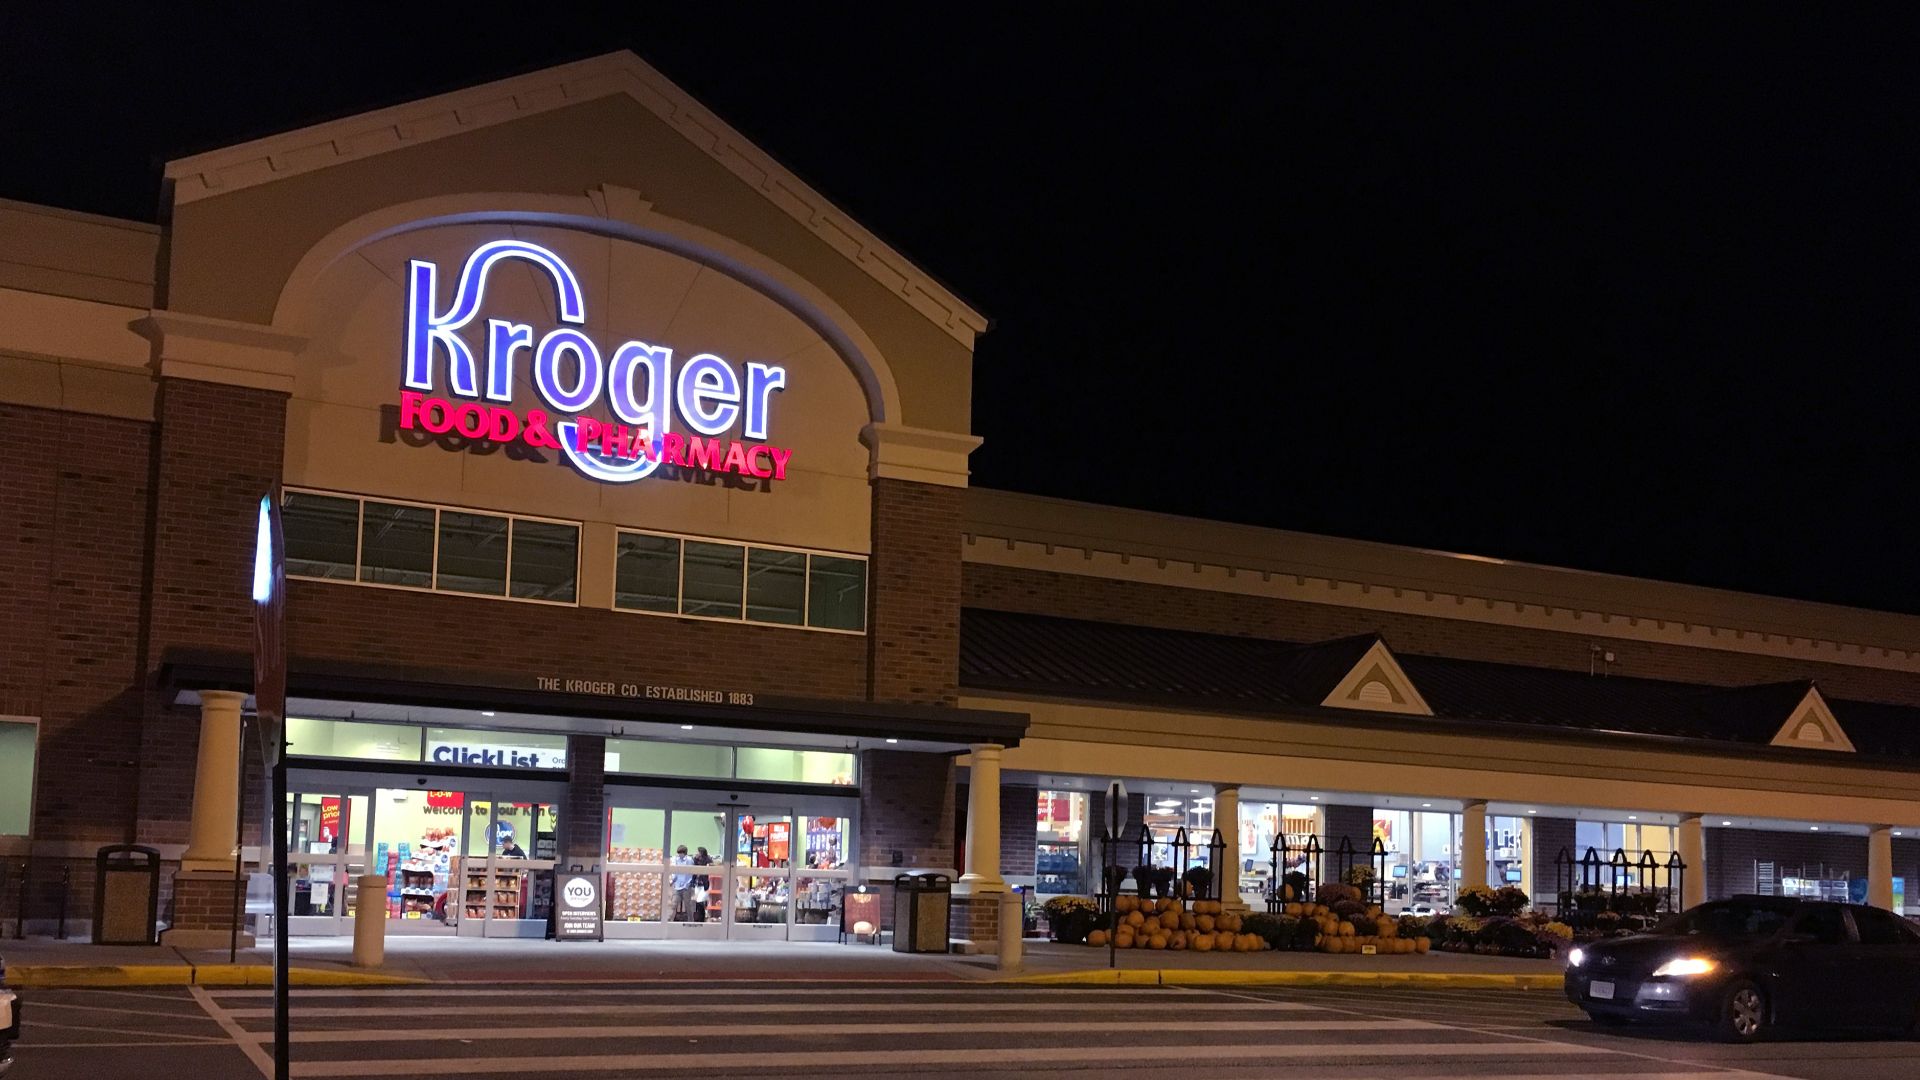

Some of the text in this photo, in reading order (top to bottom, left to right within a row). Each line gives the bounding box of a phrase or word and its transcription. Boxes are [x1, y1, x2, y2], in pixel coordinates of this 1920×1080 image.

[405, 240, 785, 482] Kroger
[399, 390, 793, 480] FOOD & PHARMACY
[537, 677, 754, 705] THE KROGER CO. ESTABLISHED 1883
[322, 804, 338, 812] Low
[423, 805, 473, 816] welcom
[475, 804, 488, 816] to
[322, 811, 340, 820] pric
[568, 887, 591, 896] YOU
